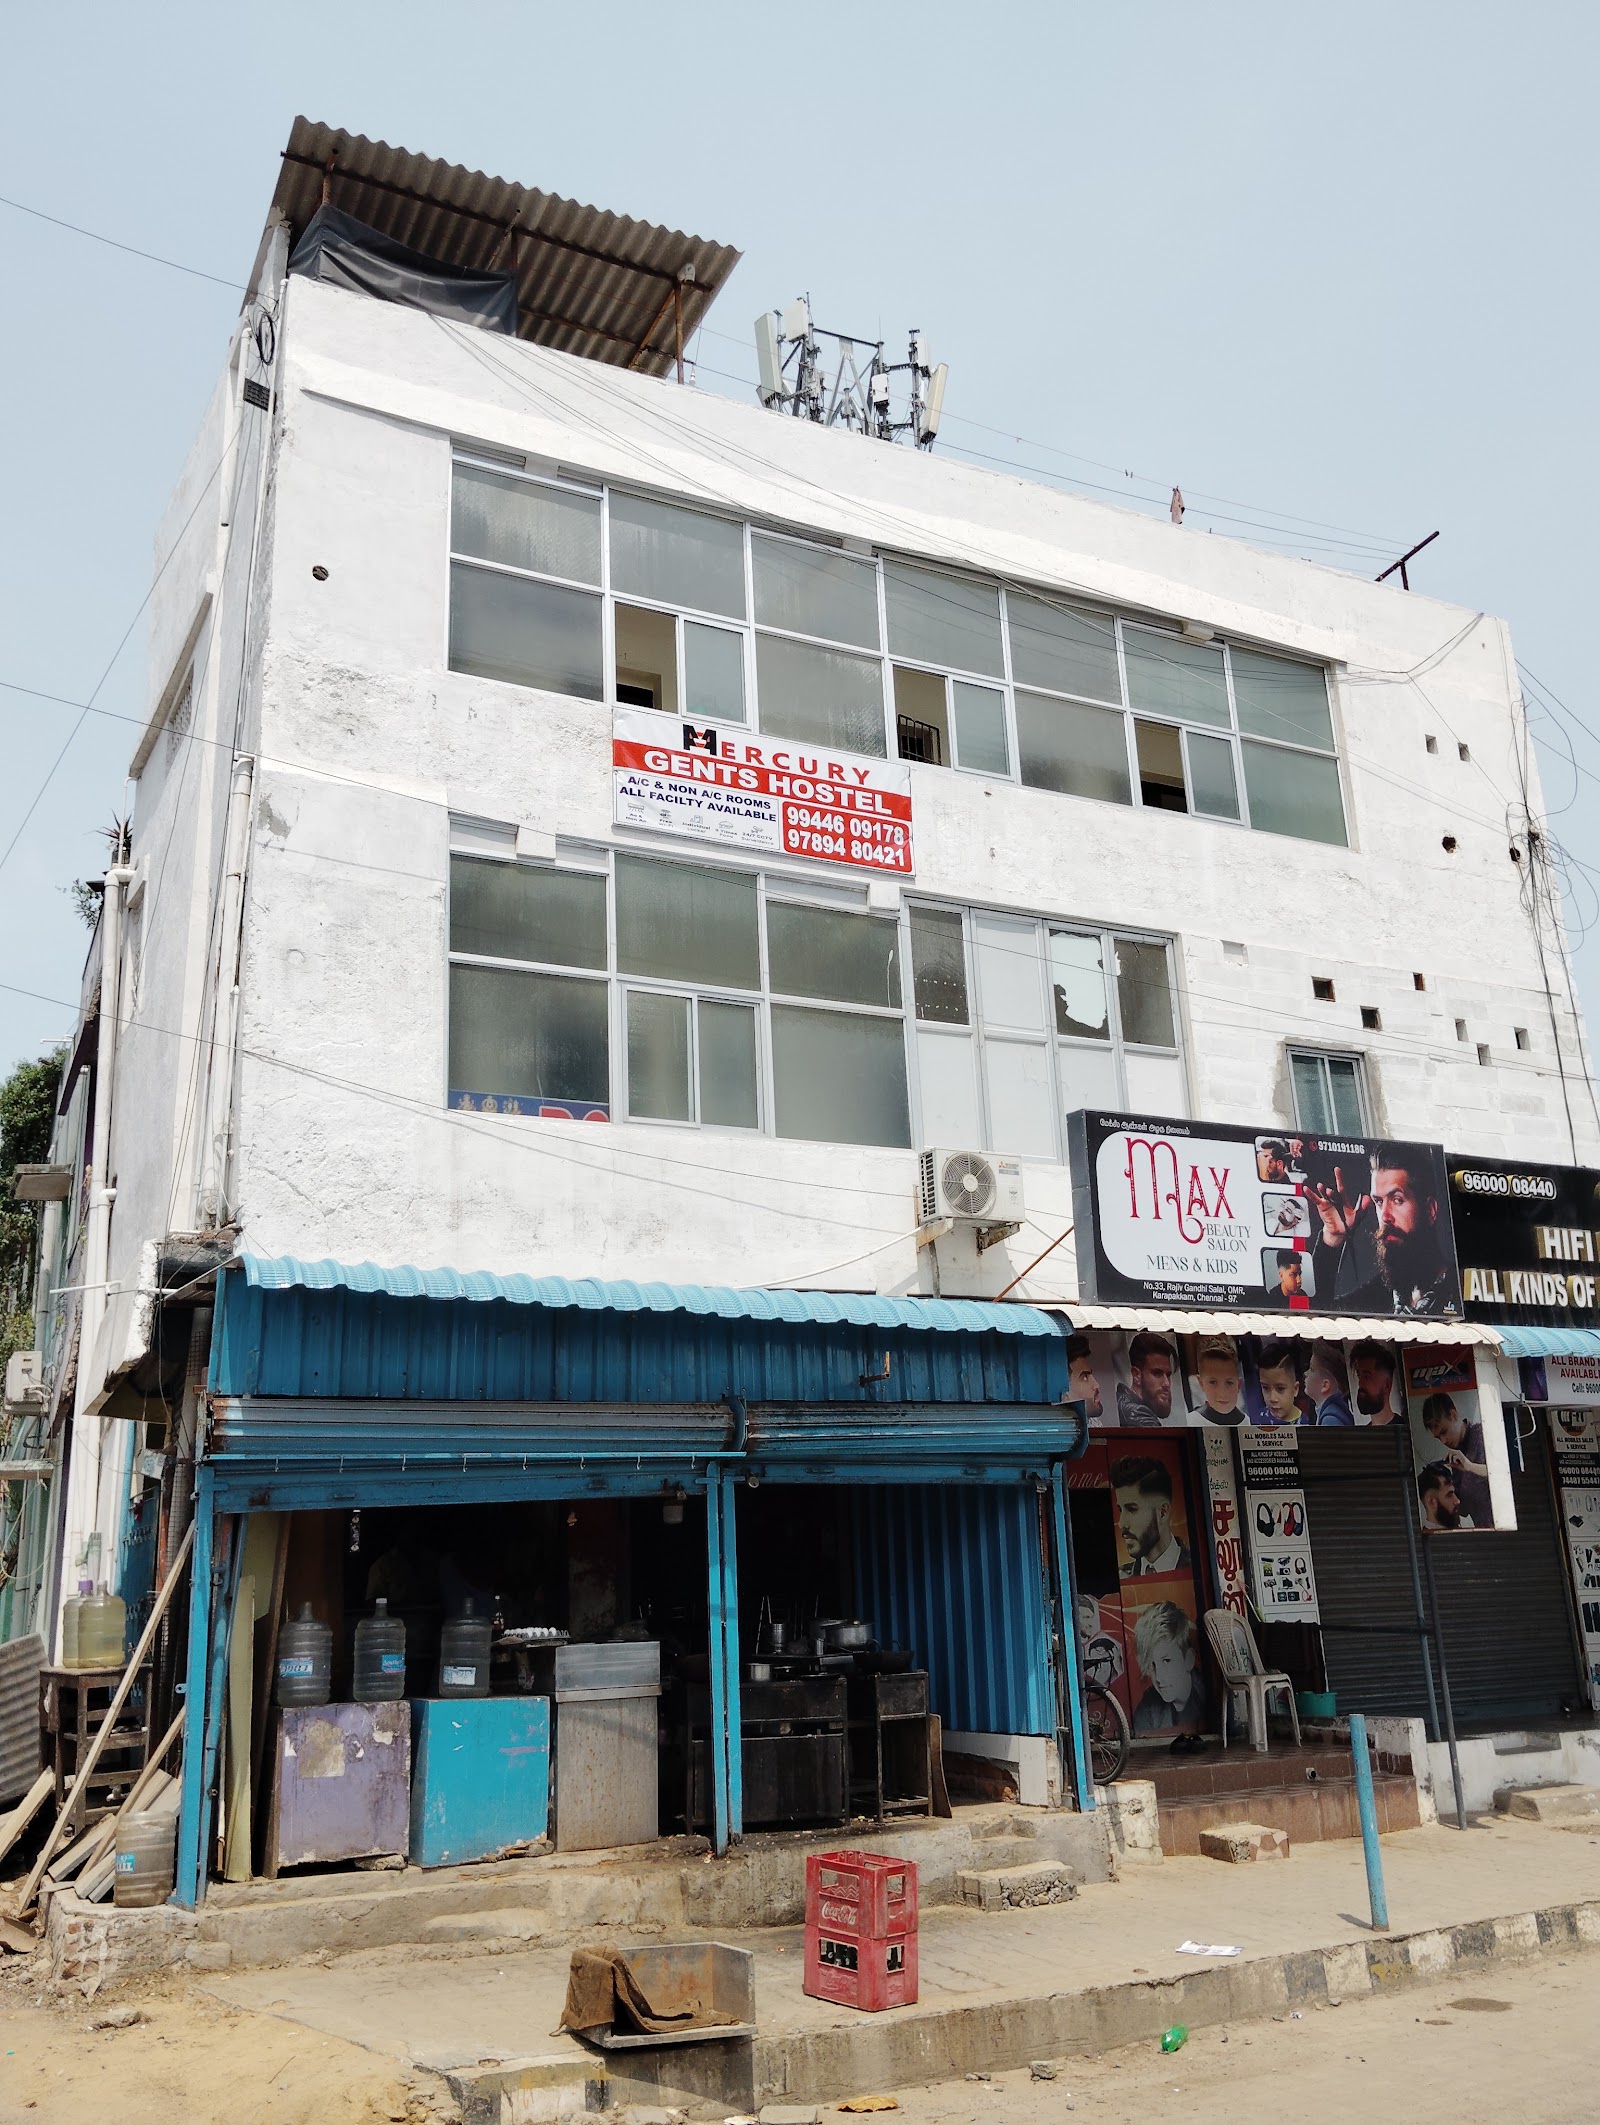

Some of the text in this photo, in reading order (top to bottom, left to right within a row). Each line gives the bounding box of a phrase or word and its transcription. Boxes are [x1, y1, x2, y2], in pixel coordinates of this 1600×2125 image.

[683, 724, 870, 785] MERCURY
[628, 775, 771, 810] A/C & NON A/C ROOMS
[644, 750, 892, 815] GENTS HOSTEL
[619, 786, 777, 823] ALL FACILTY AVAILABLE
[787, 806, 904, 845] 99446 09178
[788, 831, 904, 867] 97894 80421
[1317, 1140, 1366, 1155] 9710191186
[1123, 1136, 1236, 1245] MAX
[1464, 1173, 1554, 1199] 96000 08440
[1206, 1224, 1251, 1239] BEAUTY
[1540, 1226, 1594, 1262] HIFI
[1207, 1237, 1249, 1253] SALON
[1147, 1254, 1239, 1275] MENS & KIDS
[1143, 1281, 1166, 1293] No.33,
[1167, 1283, 1184, 1294] Rajiv
[1183, 1284, 1209, 1295] Gandhi
[1228, 1286, 1246, 1297] OMR,
[1152, 1291, 1196, 1304] Karapakkam,
[1196, 1292, 1222, 1304] Chennai
[1465, 1269, 1596, 1309] ALL KINDS OF
[1551, 1355, 1567, 1366] ALL
[1568, 1356, 1596, 1367] BRAND
[1248, 1466, 1299, 1476] 96000 08440
[1558, 1466, 1580, 1475] 96000
